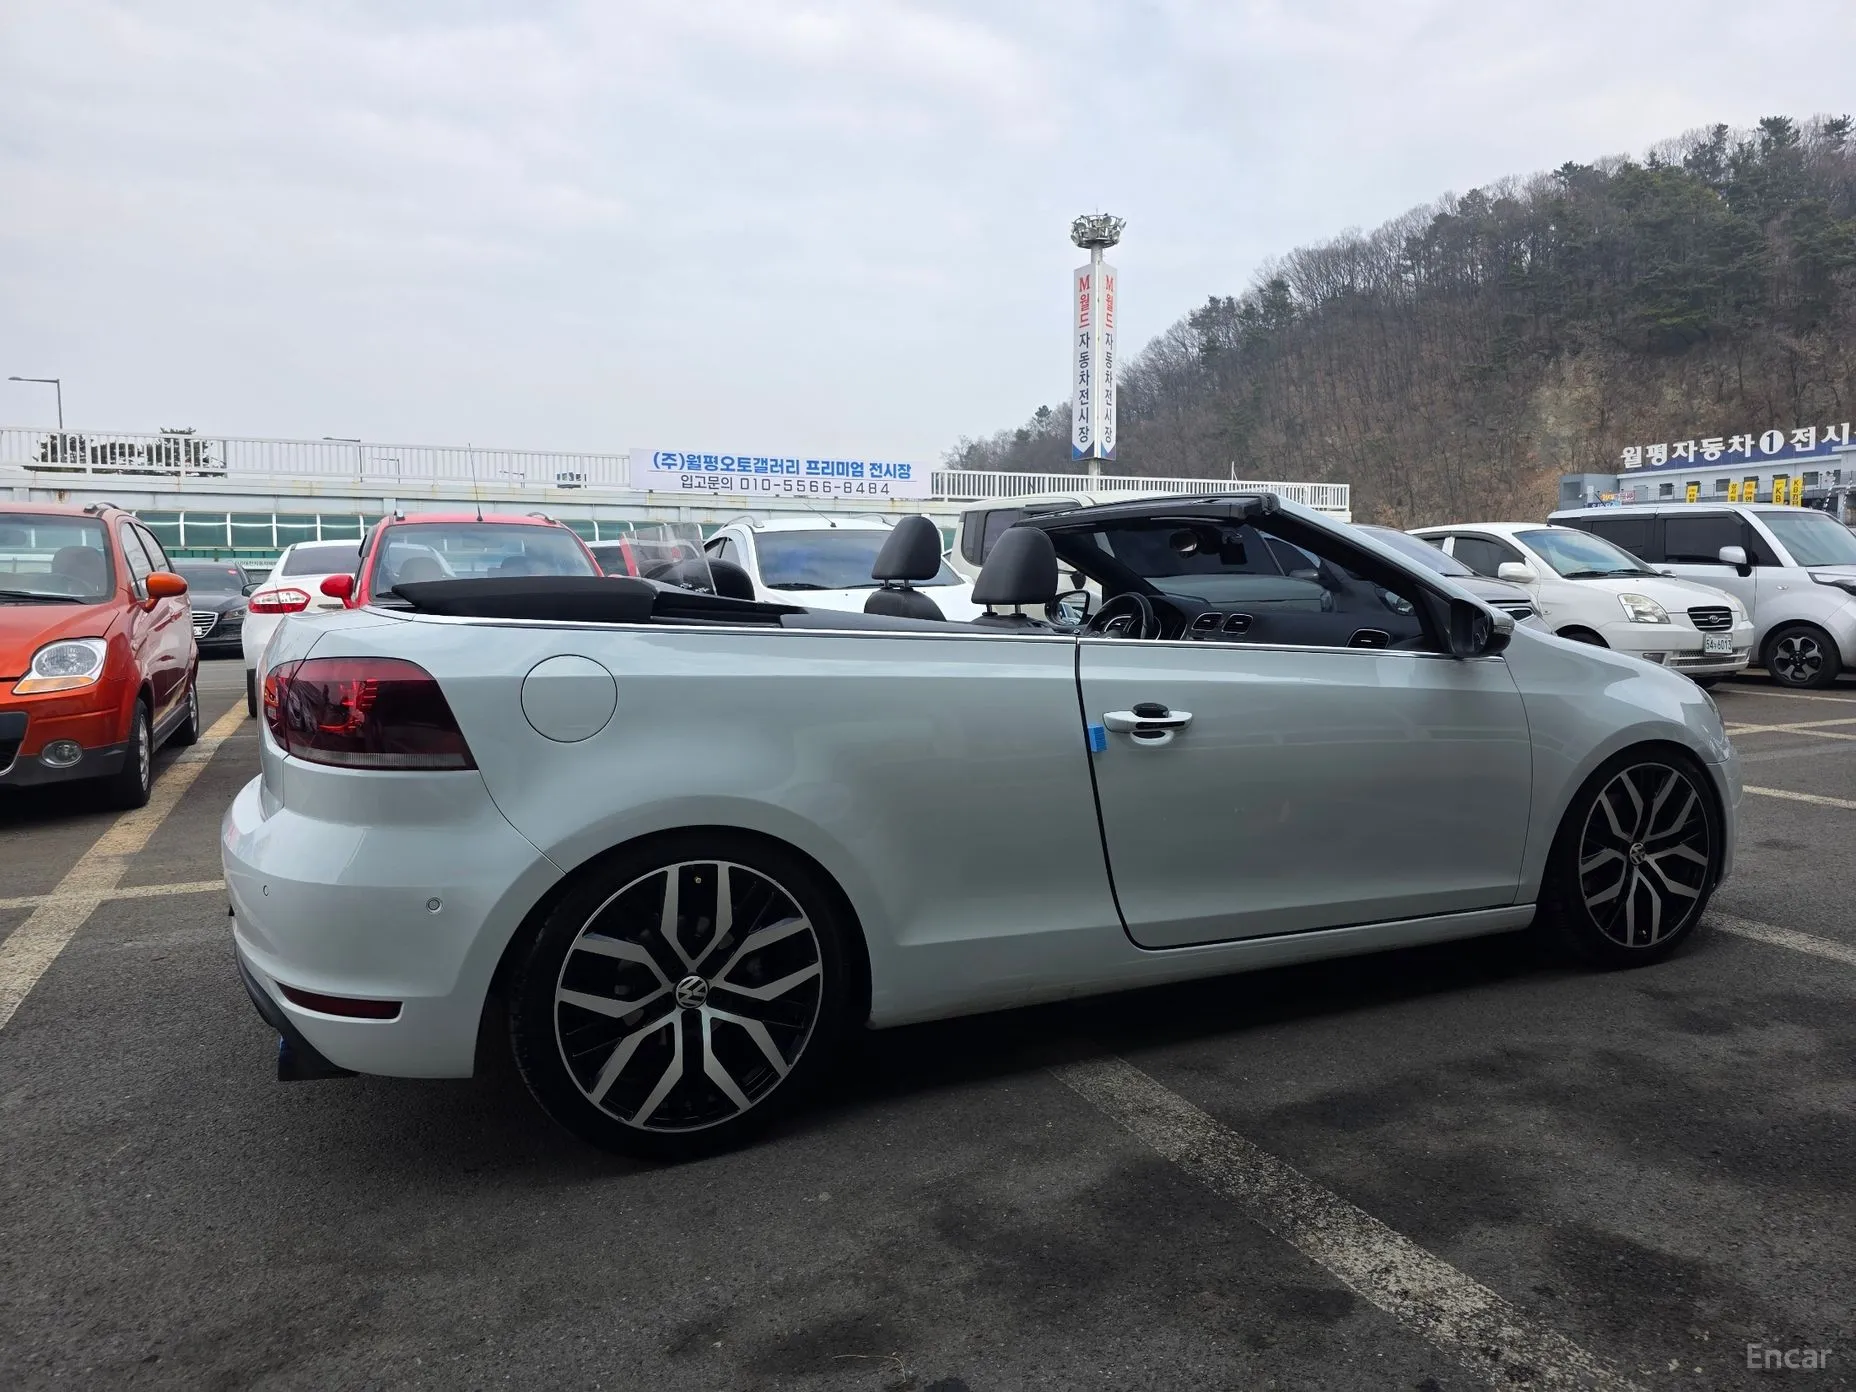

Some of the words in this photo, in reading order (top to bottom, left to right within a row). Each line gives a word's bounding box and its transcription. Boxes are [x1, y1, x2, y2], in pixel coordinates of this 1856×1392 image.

[653, 452, 800, 475] (주)월평오토갤러리
[806, 460, 864, 478] 프리미엄
[869, 462, 912, 480] 전시장
[681, 474, 733, 490] 입고문의
[740, 477, 890, 495] 010-5566-8484
